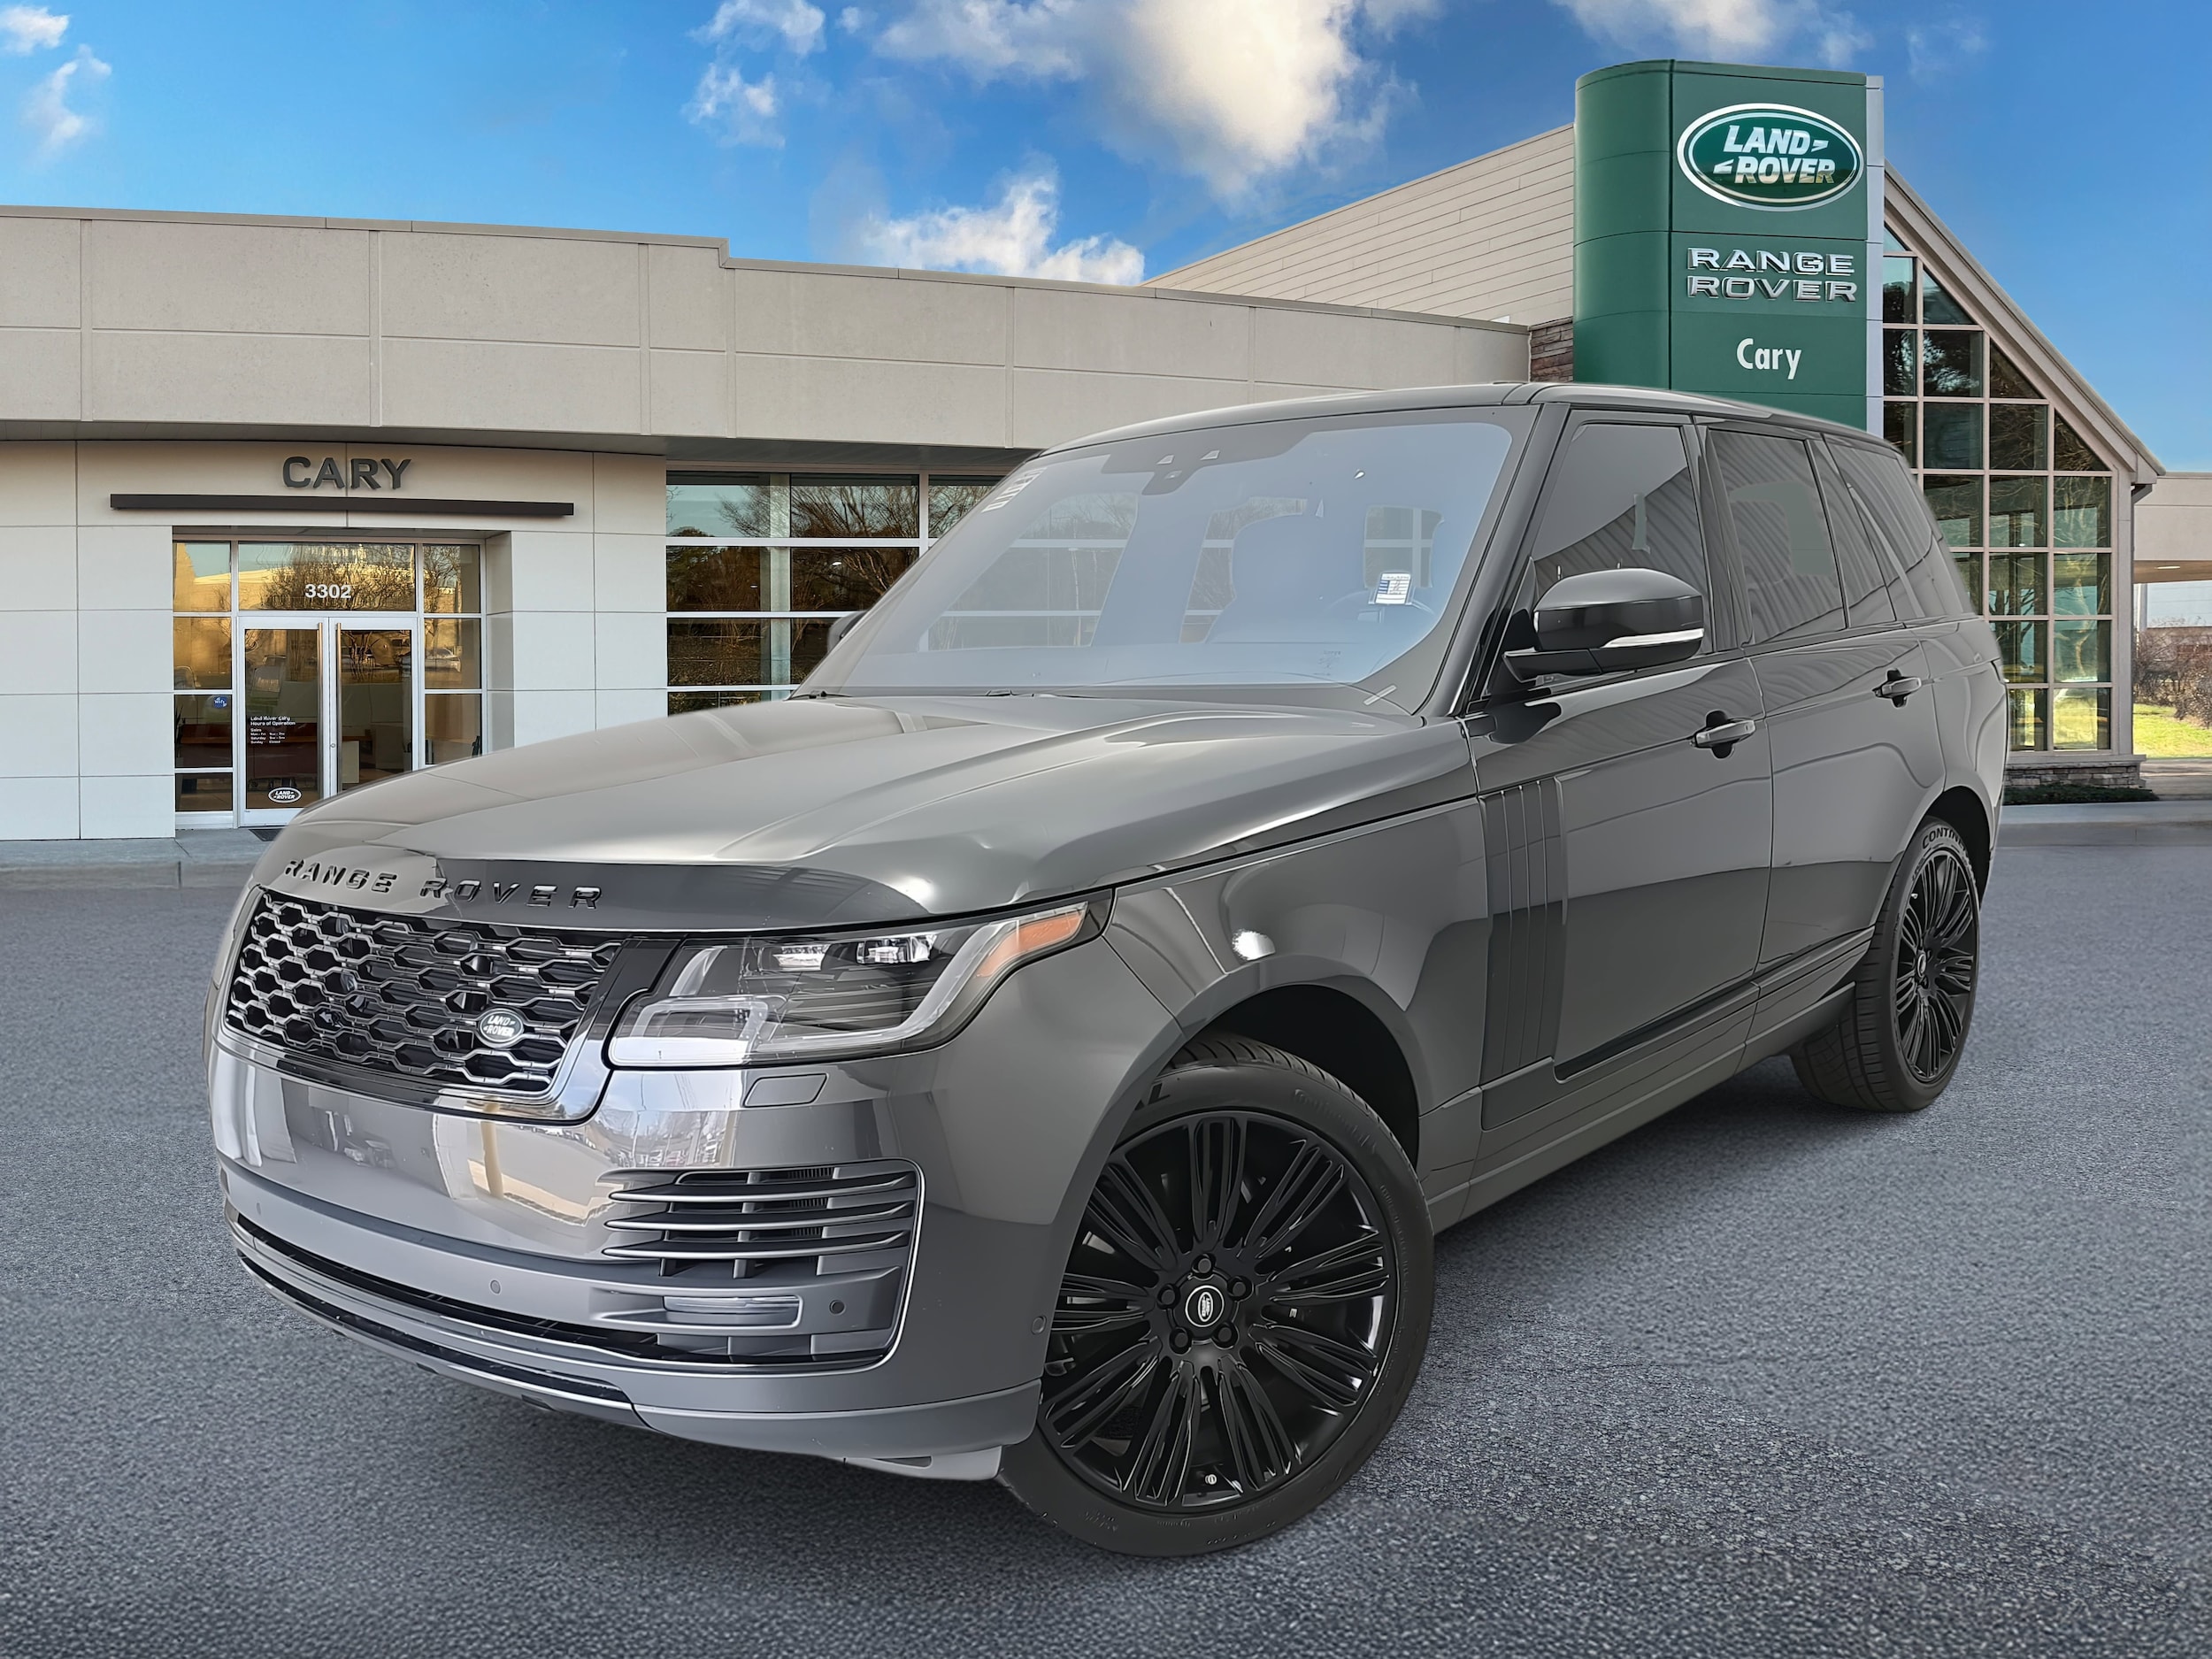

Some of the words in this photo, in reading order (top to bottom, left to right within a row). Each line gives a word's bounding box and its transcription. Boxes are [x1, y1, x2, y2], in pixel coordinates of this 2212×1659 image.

[1723, 125, 1810, 154] LAND
[1734, 157, 1836, 184] ROVER
[1686, 247, 1855, 277] RANGE
[1686, 275, 1857, 303] ROVER
[1736, 337, 1802, 380] Cary
[282, 456, 412, 490] CARY
[304, 584, 352, 599] 3302
[284, 858, 397, 894] RANGE
[419, 877, 603, 910] ROVER
[487, 1025, 515, 1037] ROVER
[488, 1015, 511, 1026] LAND
